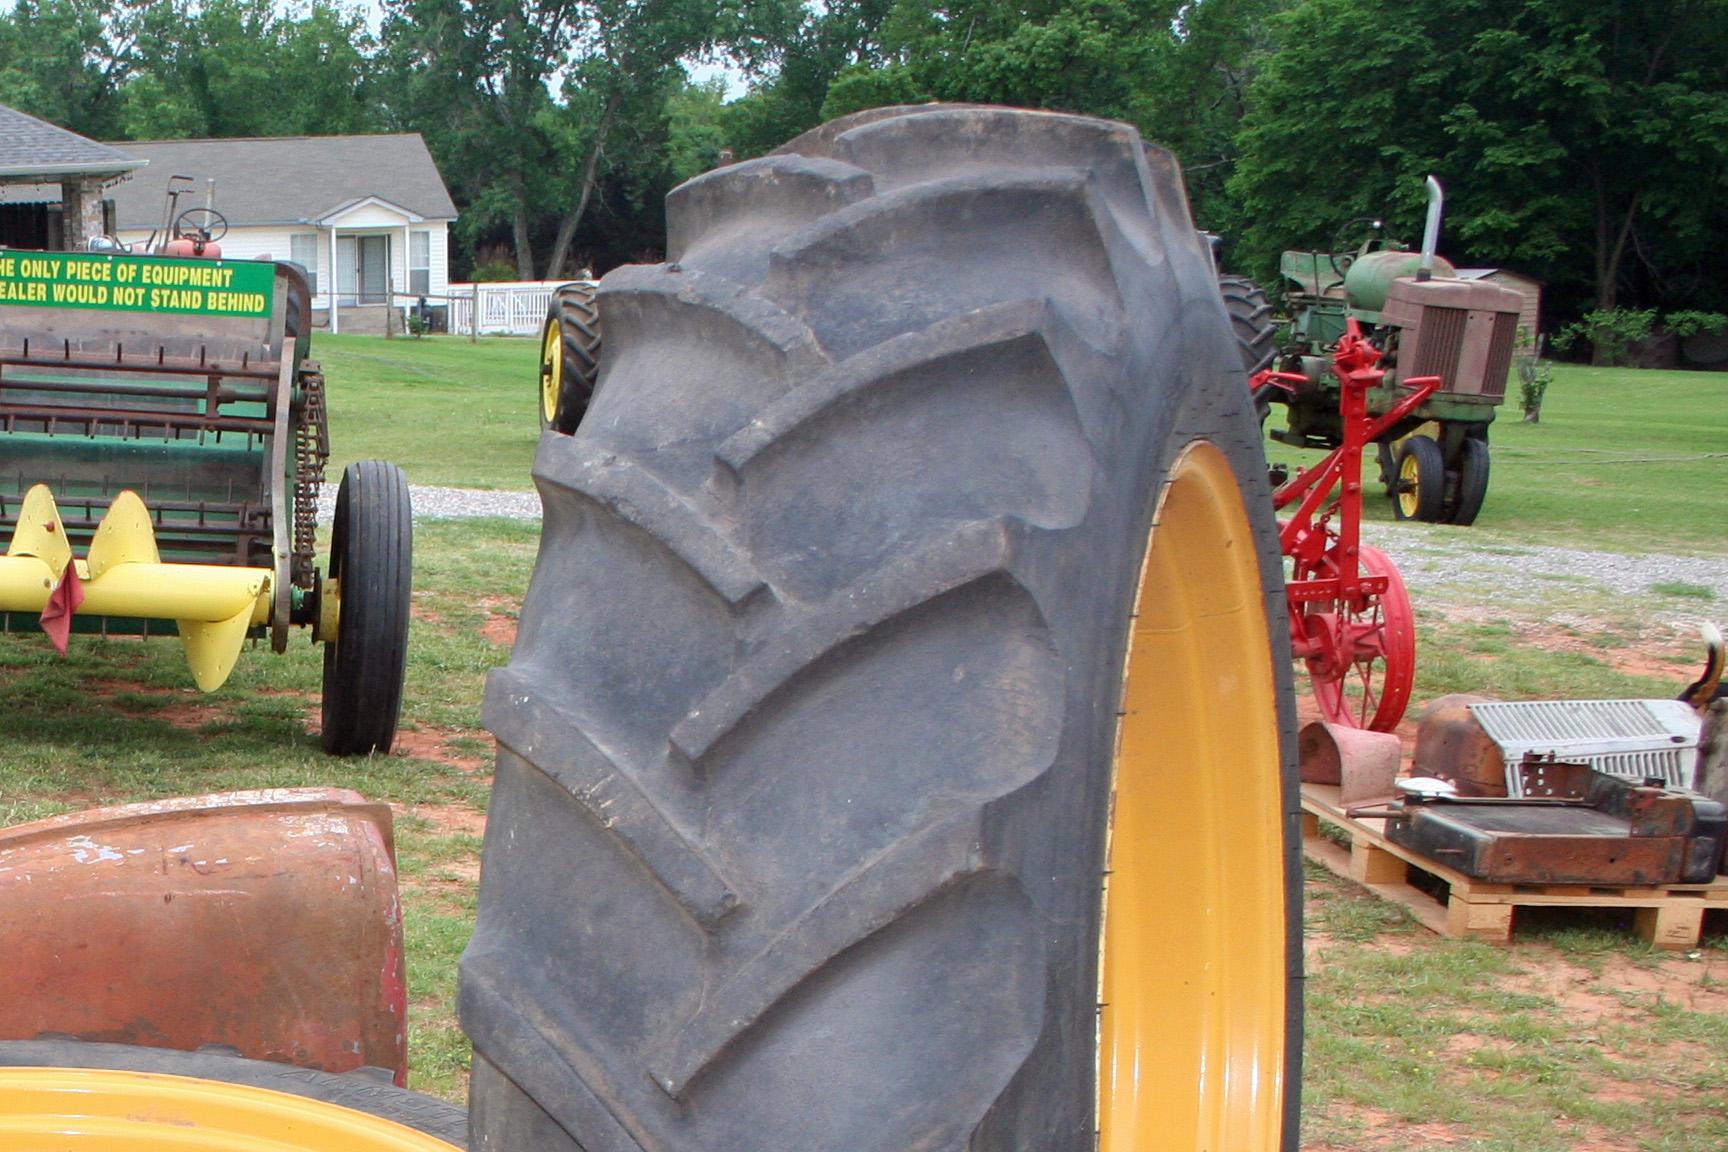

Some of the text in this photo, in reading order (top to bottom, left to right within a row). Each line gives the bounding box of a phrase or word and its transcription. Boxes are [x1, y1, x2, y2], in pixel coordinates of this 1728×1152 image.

[20, 259, 61, 279] ONLY
[66, 261, 112, 281] PIECE
[117, 264, 137, 283] OF
[142, 265, 233, 288] EQUIPMENT
[53, 284, 108, 304] WOULD
[113, 286, 145, 306] NOT
[150, 288, 202, 309] STAND
[207, 291, 265, 312] BEHIND
